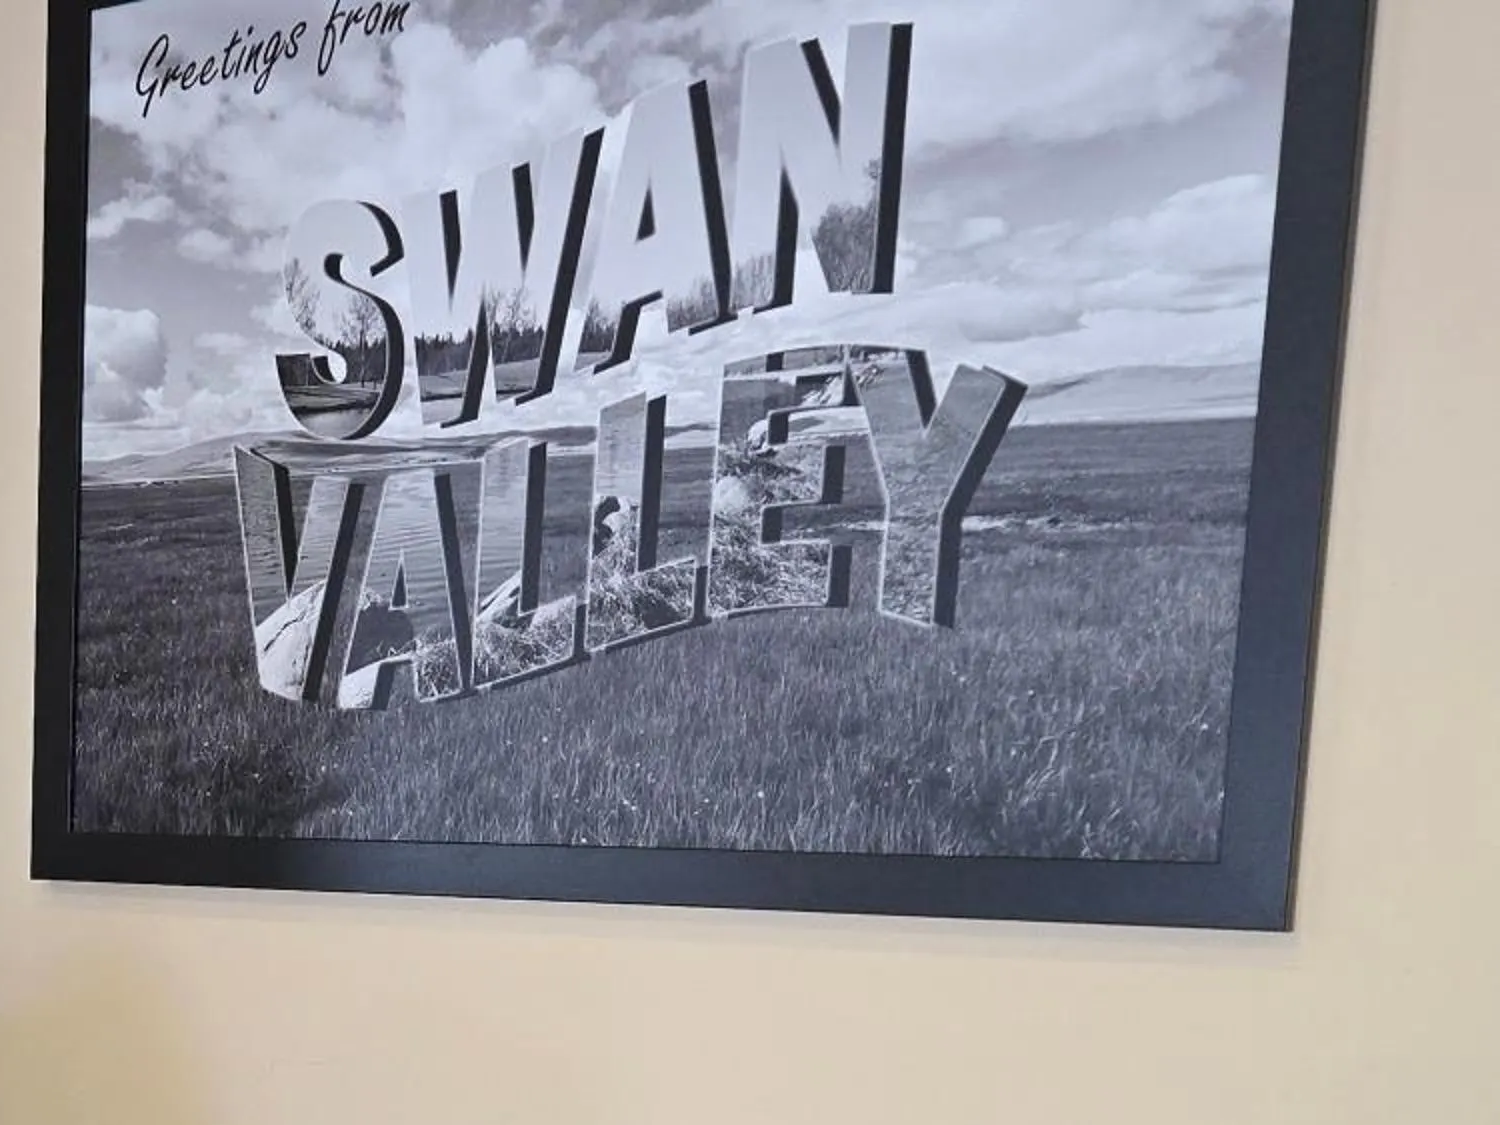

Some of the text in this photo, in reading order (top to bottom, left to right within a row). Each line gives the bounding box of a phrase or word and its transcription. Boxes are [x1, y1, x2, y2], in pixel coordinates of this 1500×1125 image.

[135, 0, 411, 118] Greetings from
[275, 22, 913, 440] SWAN
[233, 344, 1028, 711] VALLEY
